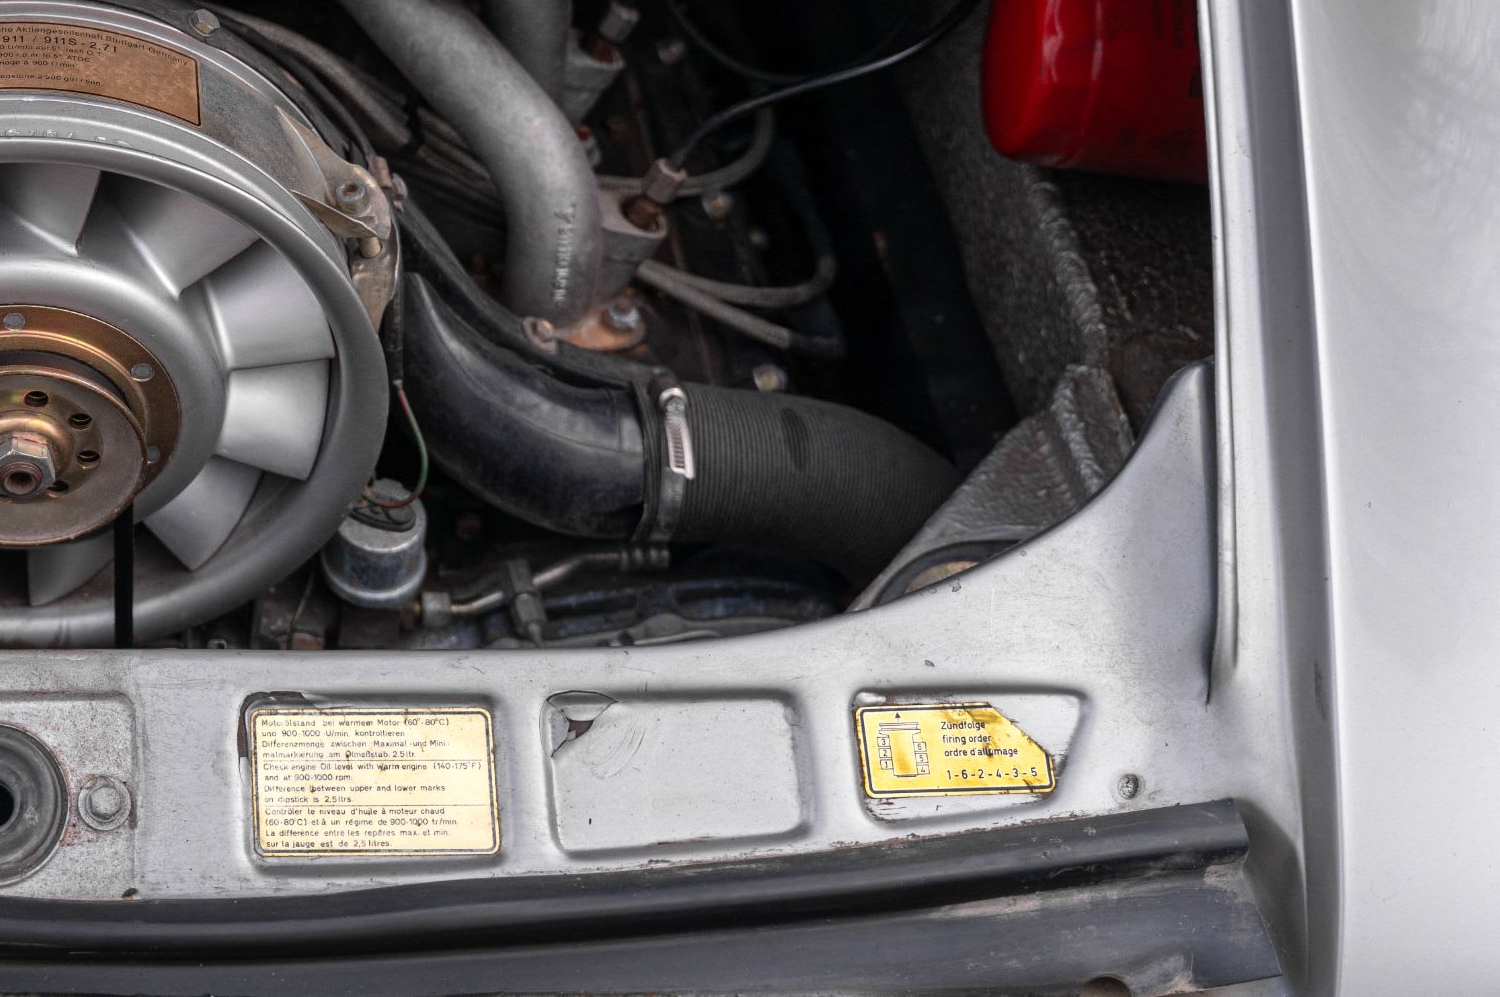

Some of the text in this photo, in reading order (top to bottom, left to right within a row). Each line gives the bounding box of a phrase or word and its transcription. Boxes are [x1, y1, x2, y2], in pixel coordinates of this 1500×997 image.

[261, 739, 325, 748] Differenzmenge
[881, 738, 886, 746] 3
[942, 735, 967, 745] firing
[944, 747, 1018, 757] ordre d'allumage
[919, 754, 924, 762] 5
[263, 763, 289, 771] Check
[291, 764, 316, 772] engine
[335, 763, 353, 771] level
[401, 764, 427, 772] engine
[310, 785, 346, 793] between
[350, 785, 373, 794] upper
[376, 784, 391, 792] and
[394, 784, 417, 792] lower
[345, 819, 373, 827] régime
